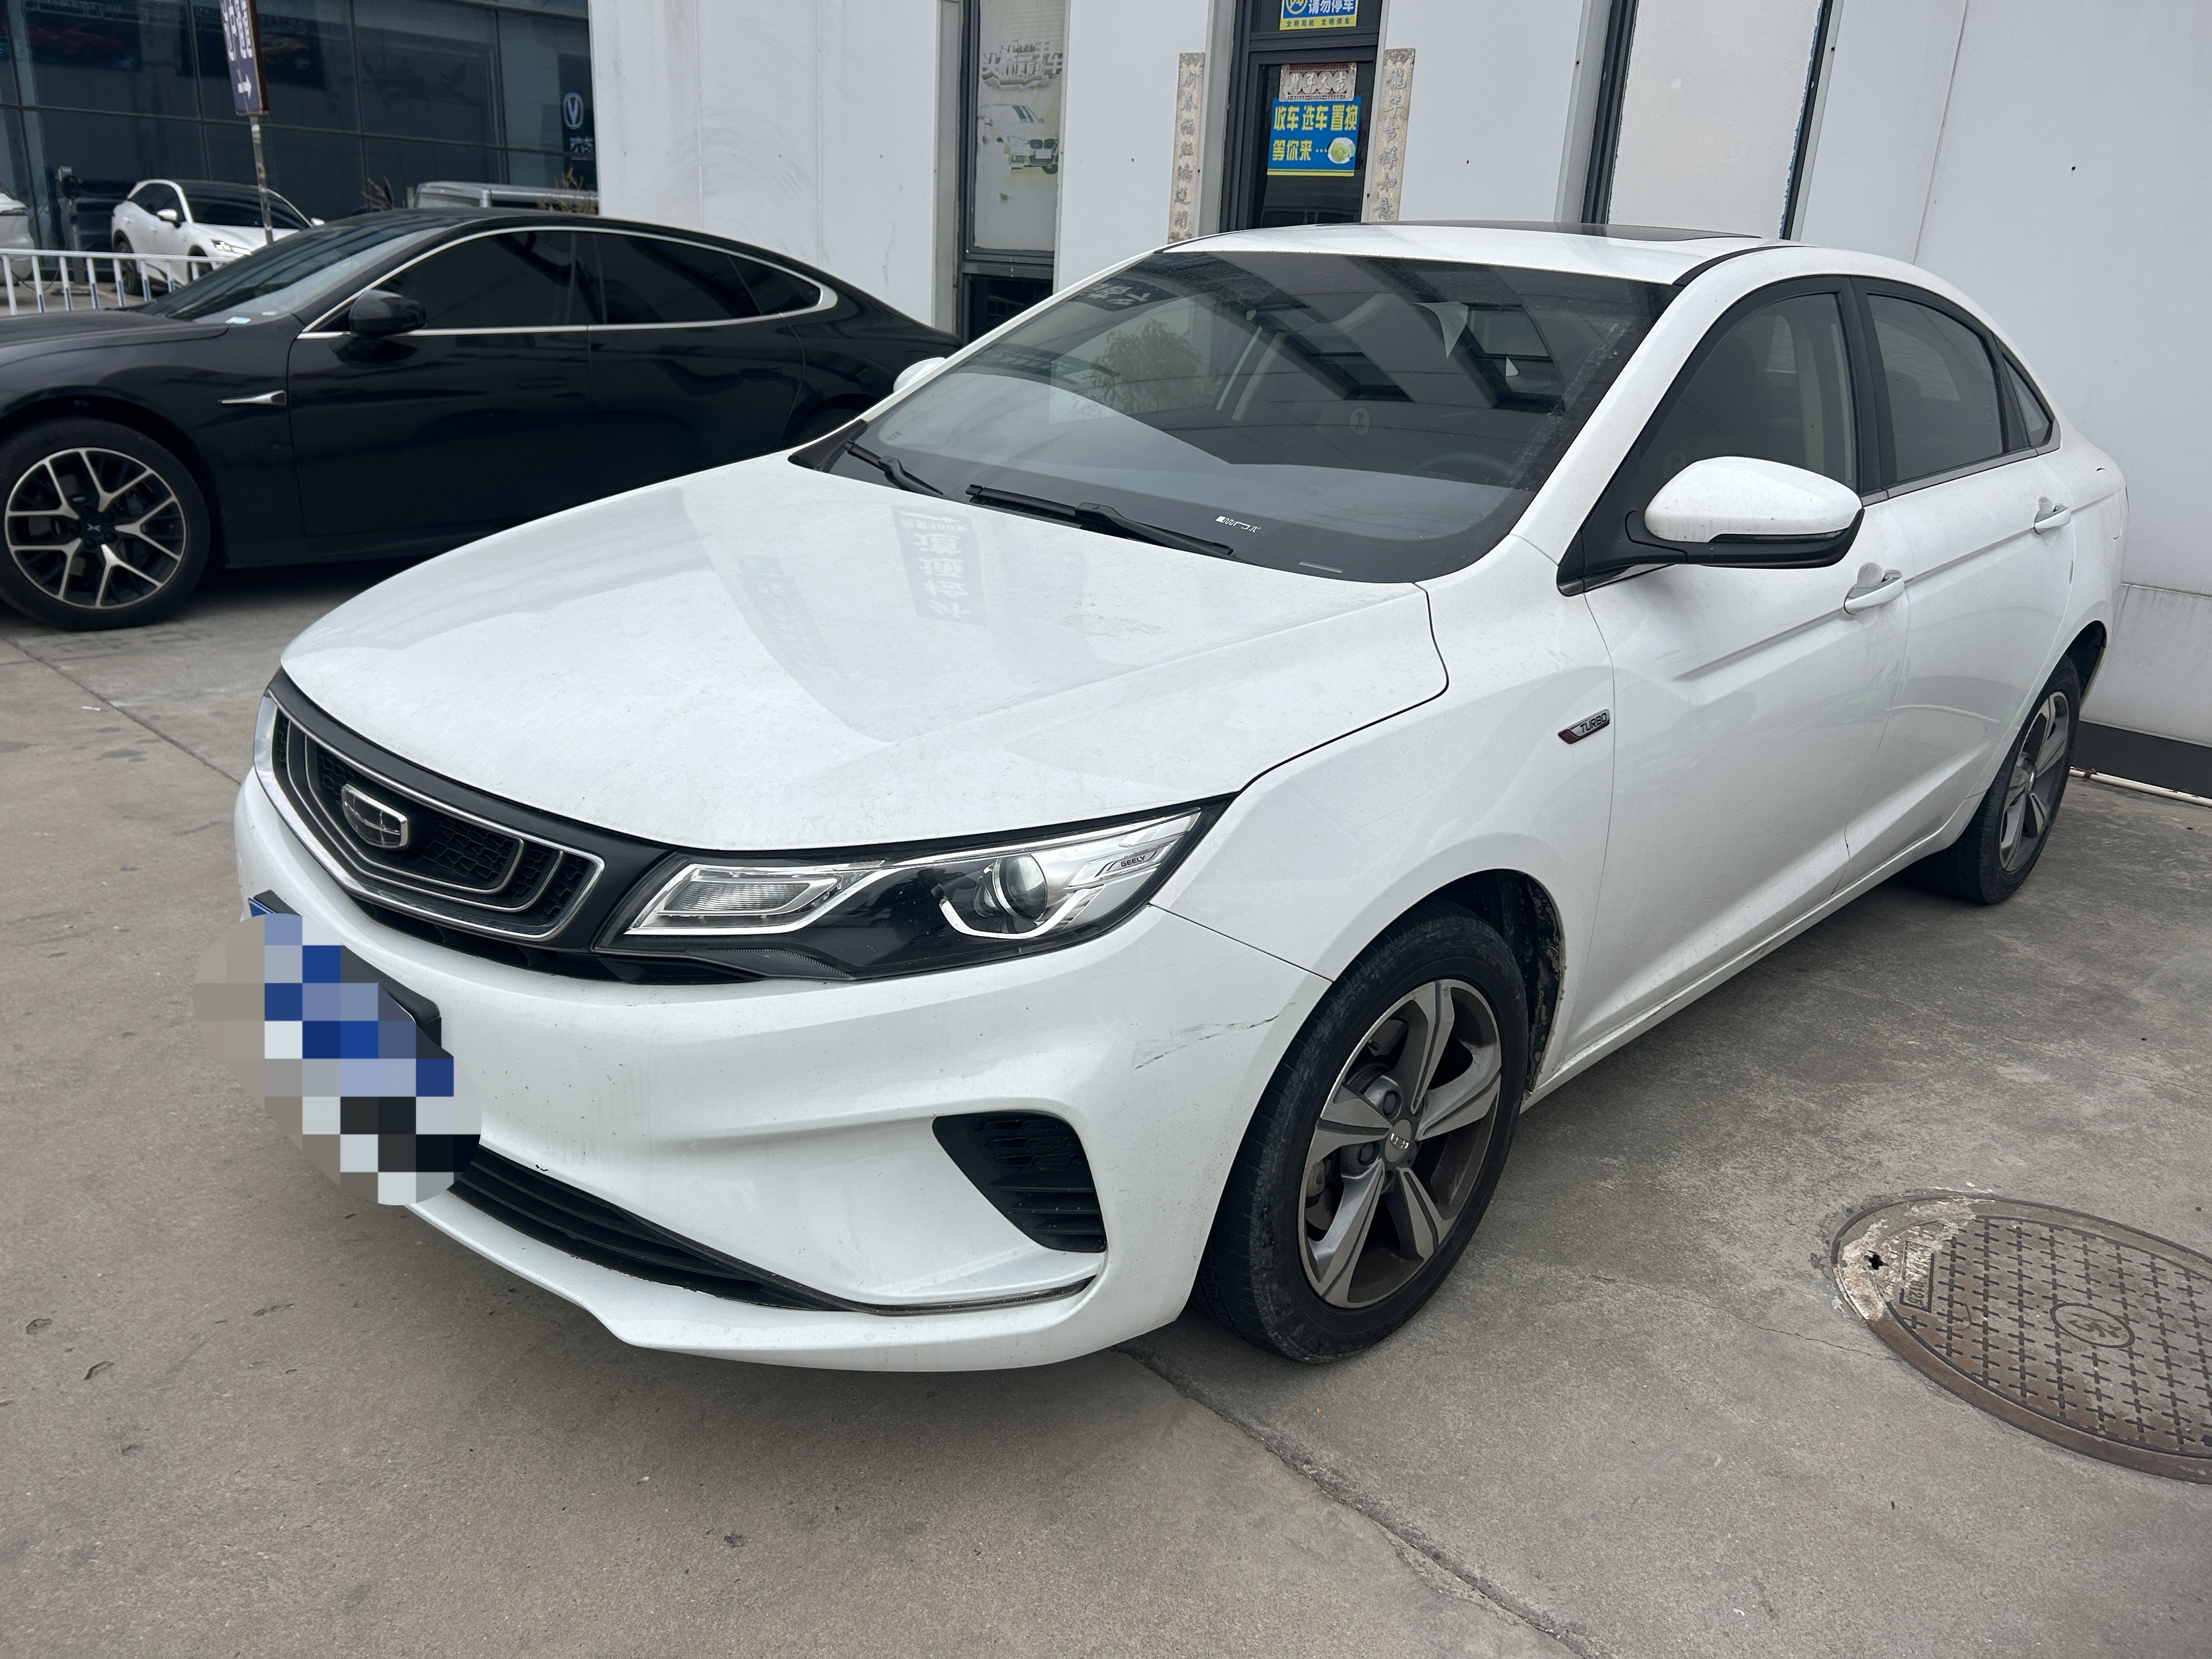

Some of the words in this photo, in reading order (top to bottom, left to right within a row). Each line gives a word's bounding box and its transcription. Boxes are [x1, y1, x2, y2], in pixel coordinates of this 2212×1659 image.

[1308, 0, 1355, 14] 请勿停车
[1321, 17, 1350, 26] 文明停车
[1273, 106, 1300, 131] 收车
[1301, 105, 1329, 131] 选车
[1330, 105, 1358, 131] 置换
[1580, 712, 1607, 734] TURBO
[1121, 855, 1146, 867] GEELY
